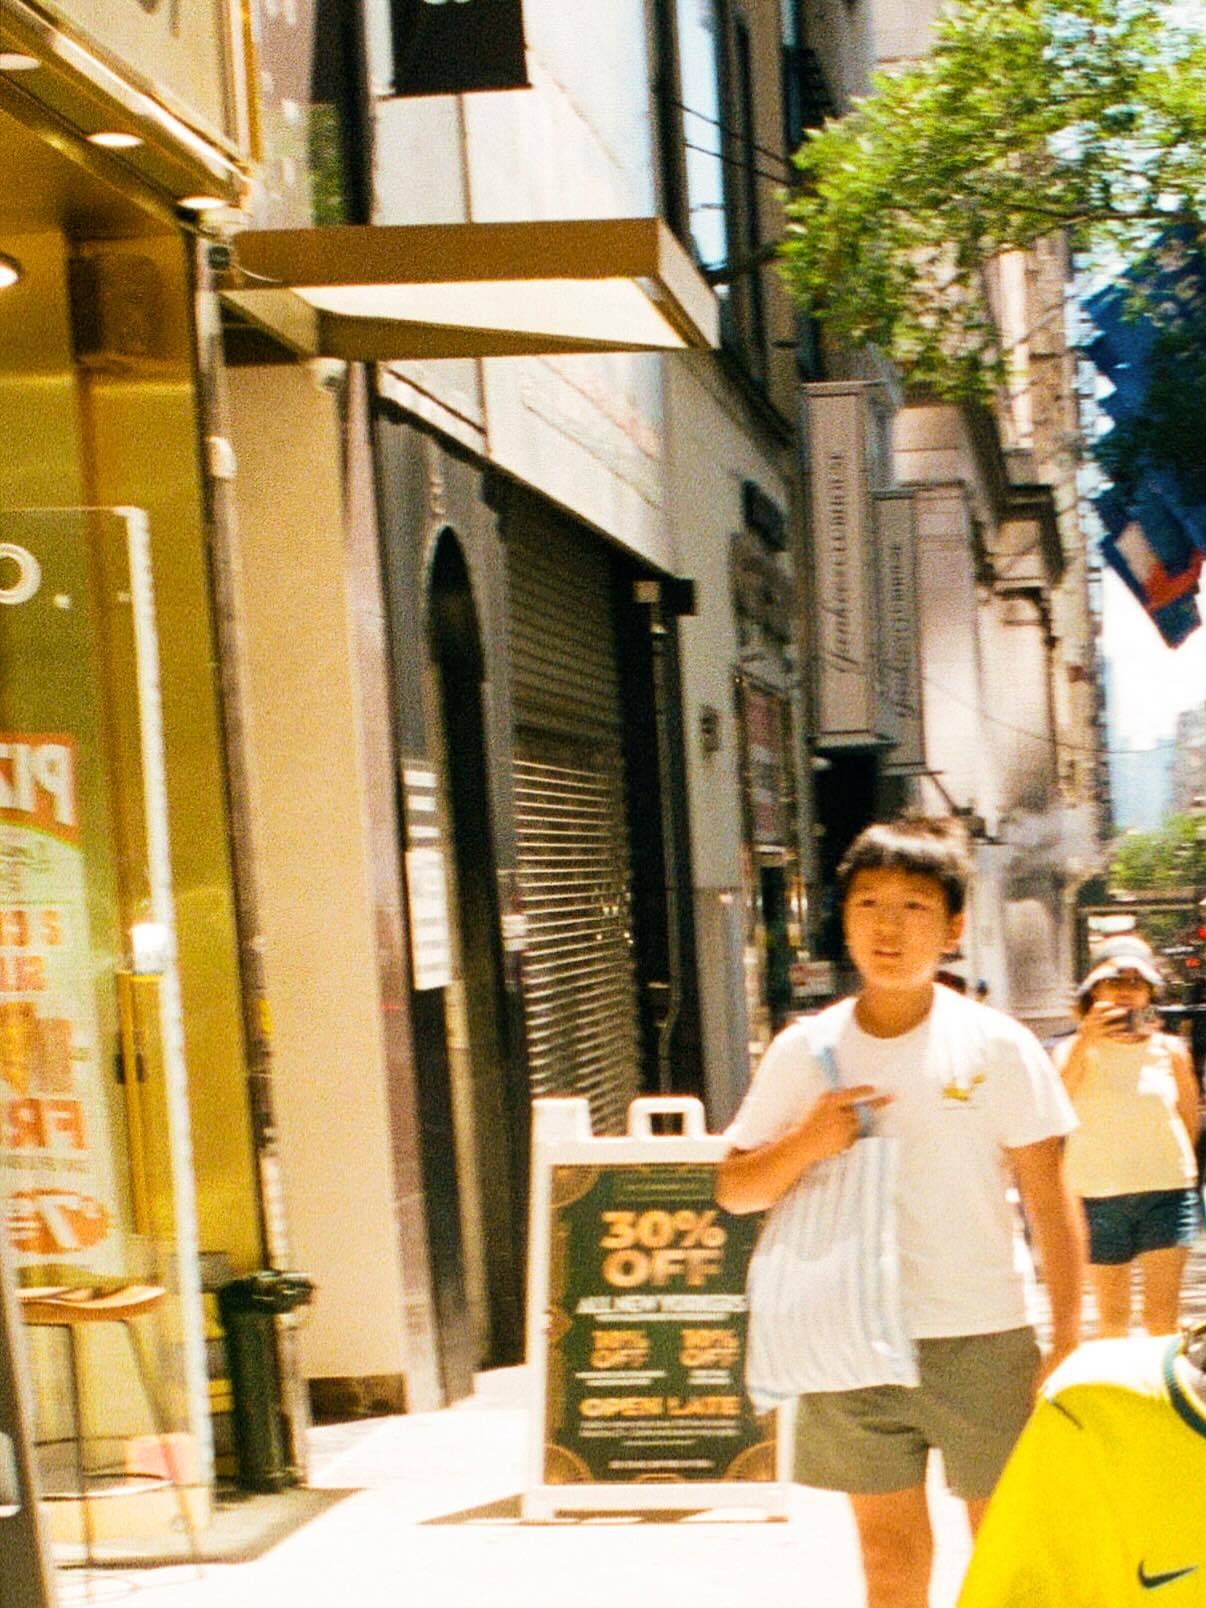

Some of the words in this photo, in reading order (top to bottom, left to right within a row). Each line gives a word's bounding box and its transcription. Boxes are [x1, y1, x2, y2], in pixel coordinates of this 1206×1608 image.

[600, 1210, 727, 1249] 30%
[602, 1249, 724, 1288] OFF
[579, 1396, 664, 1417] OPEN
[667, 1396, 742, 1416] LATE
